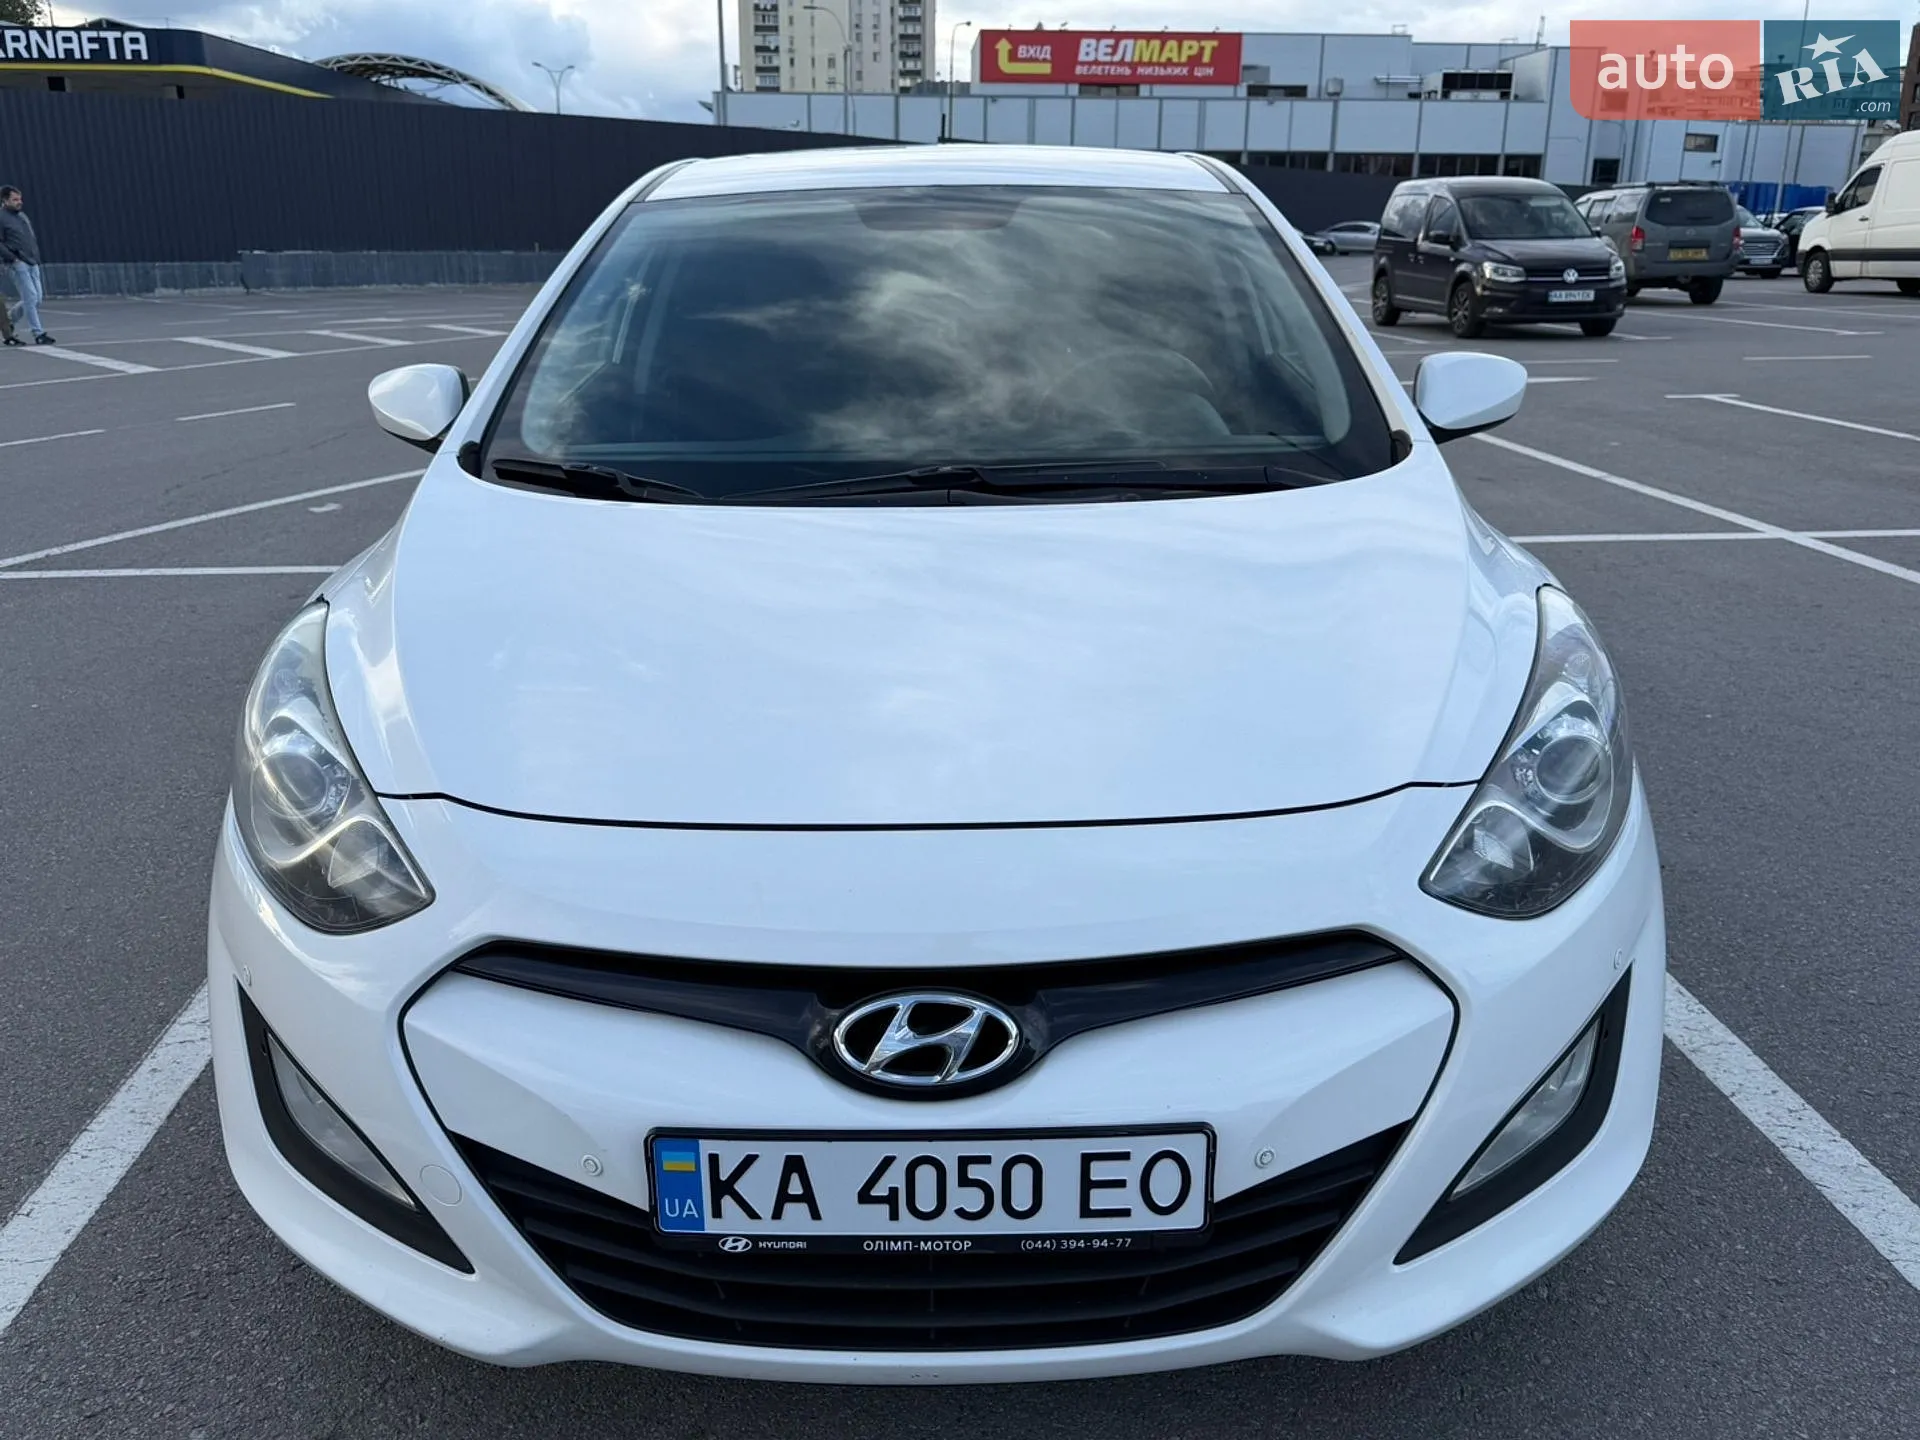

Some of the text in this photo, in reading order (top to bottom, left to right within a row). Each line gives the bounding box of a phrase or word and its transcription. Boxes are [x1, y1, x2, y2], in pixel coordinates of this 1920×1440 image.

[0, 28, 149, 60] RNAFTA
[1017, 44, 1053, 60] ВХІД
[1077, 38, 1219, 63] ВЕЛМАРТ
[1075, 64, 1133, 76] ВЕЛЕТЕНЬ
[1136, 65, 1189, 76] НИЗЬКИХ
[708, 1149, 1192, 1221] KA 4050 EO
[664, 1198, 699, 1218] UA
[758, 1240, 807, 1250] HYUNDAI
[863, 1240, 972, 1252] ОЛІМП-МОТОР
[1020, 1238, 1132, 1251] (044) 394-94-77
